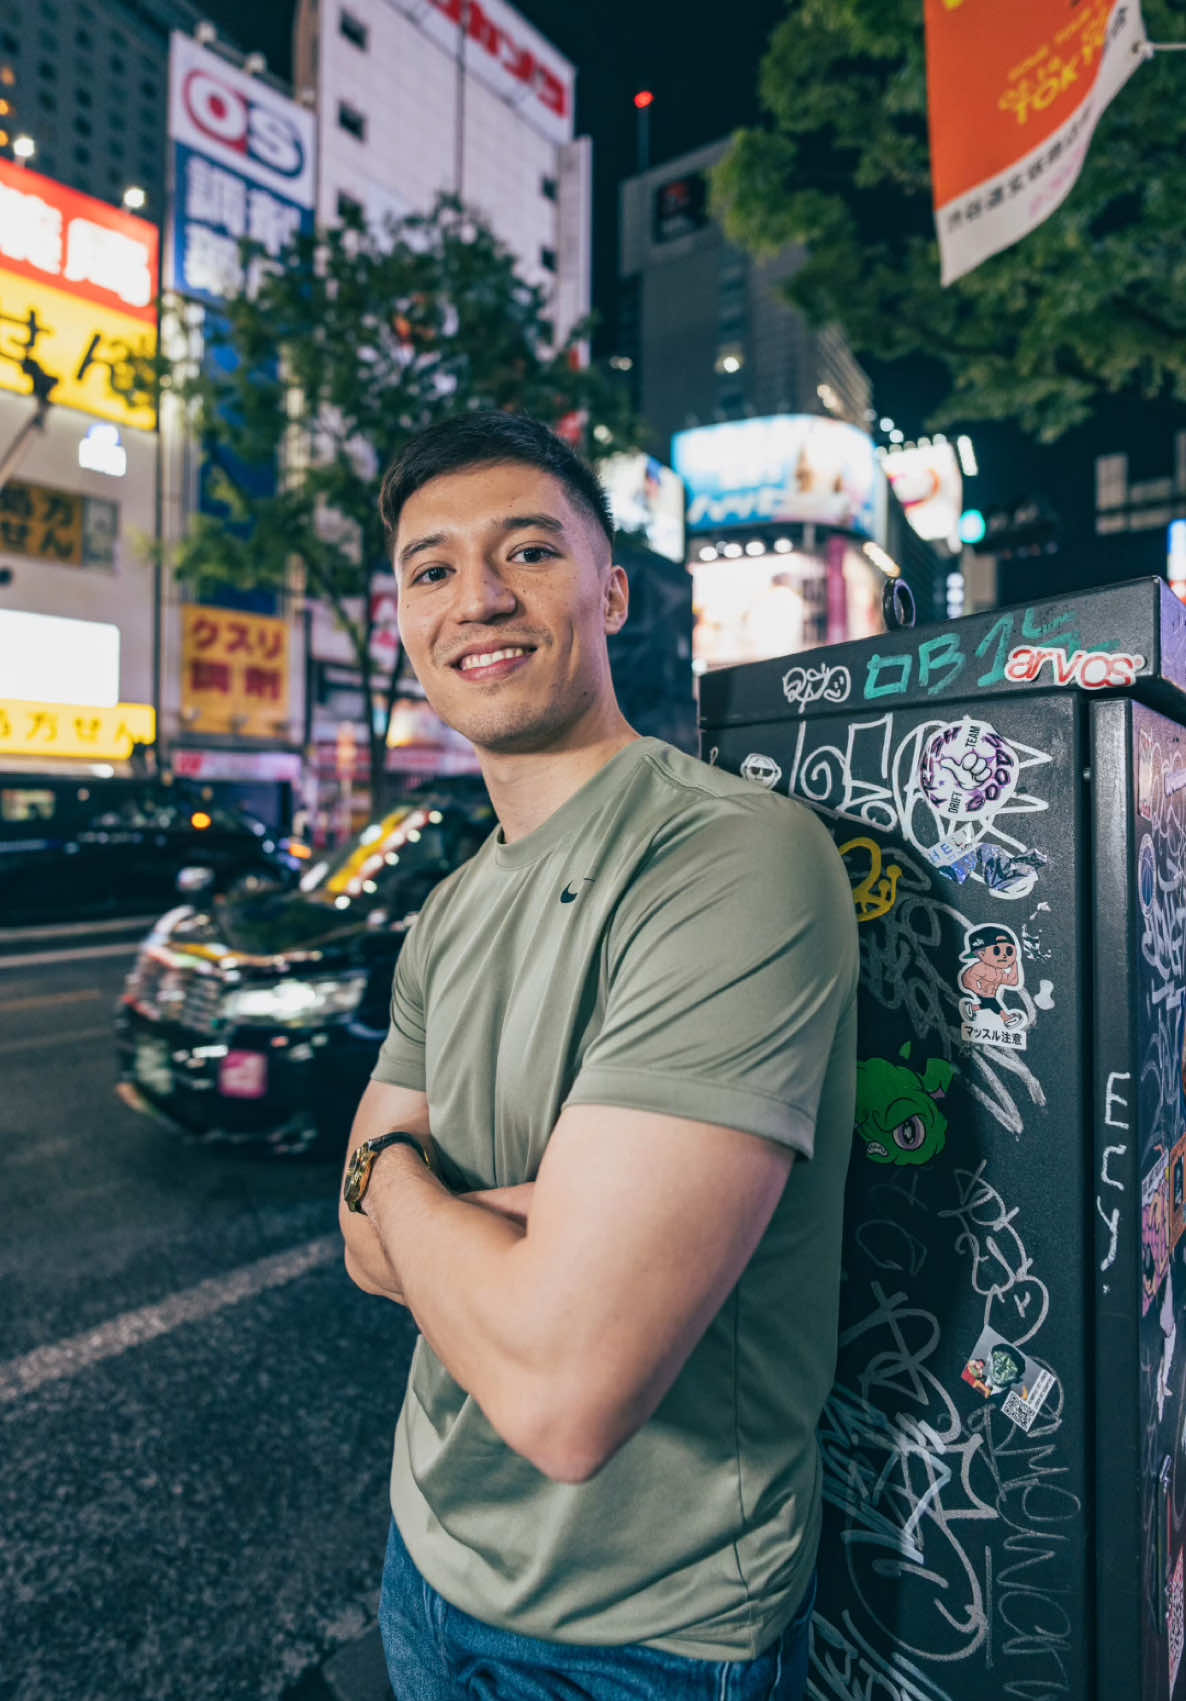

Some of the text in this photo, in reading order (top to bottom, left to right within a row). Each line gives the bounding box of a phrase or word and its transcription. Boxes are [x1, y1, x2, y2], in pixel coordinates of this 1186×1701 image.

[192, 617, 282, 660] クスリ
[1007, 647, 1134, 688] arvos
[965, 725, 981, 748] TEAM
[948, 791, 963, 814] DRIFT
[963, 1025, 1022, 1046] マッスル注意
